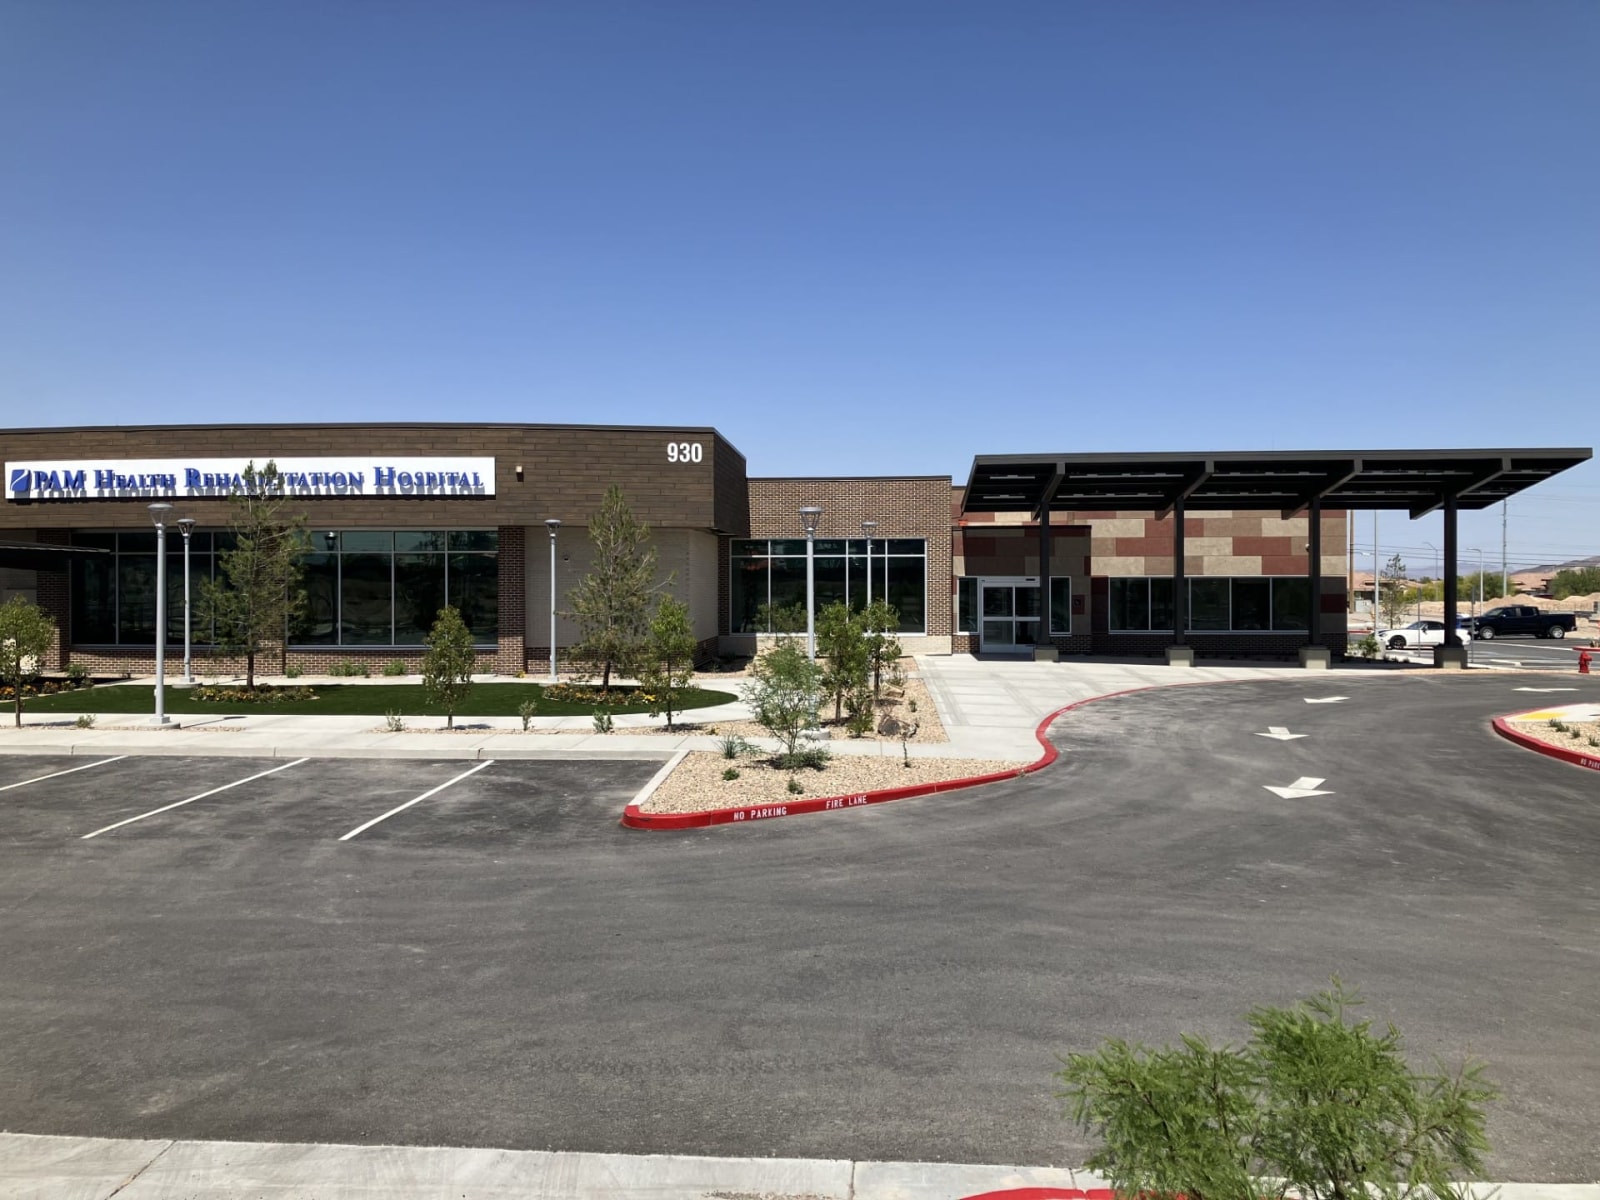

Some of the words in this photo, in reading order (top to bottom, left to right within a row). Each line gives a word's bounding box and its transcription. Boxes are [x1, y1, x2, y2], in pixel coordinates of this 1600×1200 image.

[667, 442, 703, 463] 930
[33, 469, 86, 491] PAM
[93, 469, 177, 489] HEALTH
[184, 467, 364, 489] REHAILTATION
[373, 466, 484, 487] HOSPITAL
[733, 811, 745, 821] NO
[750, 807, 787, 819] PARKING
[825, 800, 844, 809] FIRE
[848, 795, 868, 806] LANE
